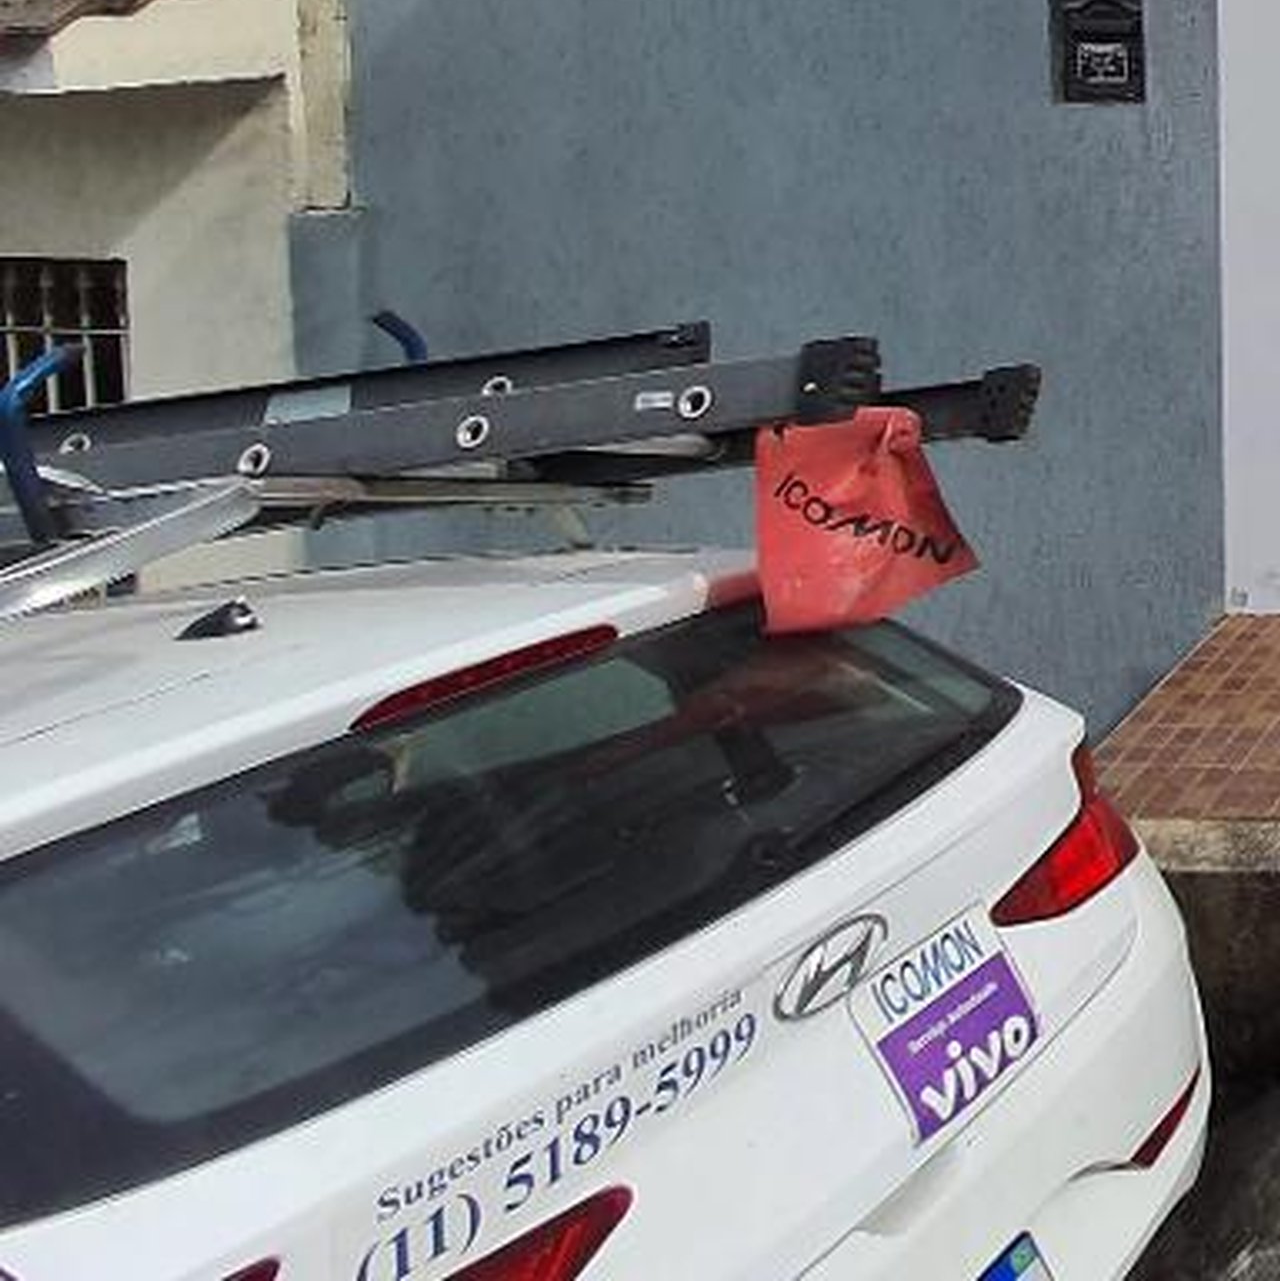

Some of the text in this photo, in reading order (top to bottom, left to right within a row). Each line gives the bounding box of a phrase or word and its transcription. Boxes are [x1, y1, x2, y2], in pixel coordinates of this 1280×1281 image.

[773, 473, 965, 565] ICOMON
[869, 919, 985, 1024] ICOMON
[376, 988, 743, 1221] Sugestões para melhoria
[920, 1016, 1030, 1120] vivo
[356, 1193, 483, 1281] (11)
[503, 1013, 757, 1213] 5189-5999
